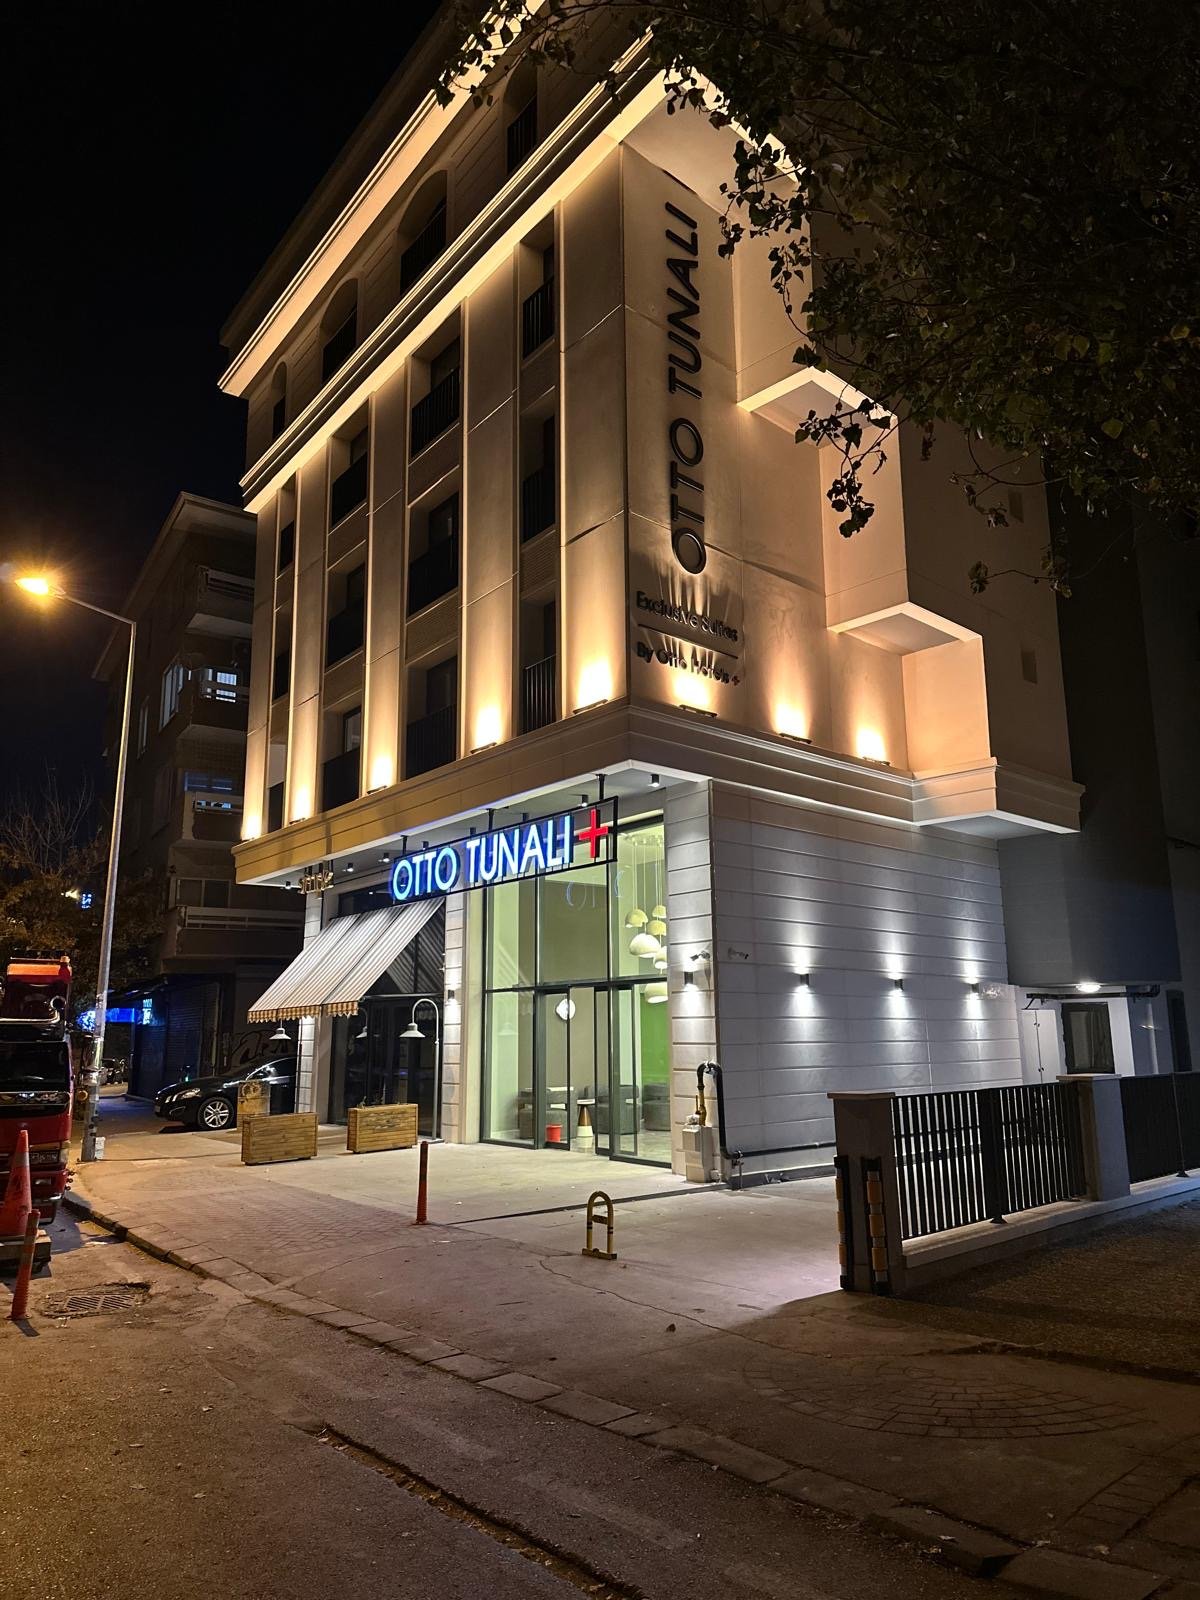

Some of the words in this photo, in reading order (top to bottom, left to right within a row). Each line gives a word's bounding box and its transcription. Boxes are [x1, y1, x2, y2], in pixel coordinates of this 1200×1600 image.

[665, 201, 703, 400] TUNALI
[669, 417, 707, 575] OTTO
[636, 641, 655, 664] By
[701, 615, 738, 642] Suites
[392, 846, 460, 901] OTTO
[466, 812, 575, 885] TUNALI
